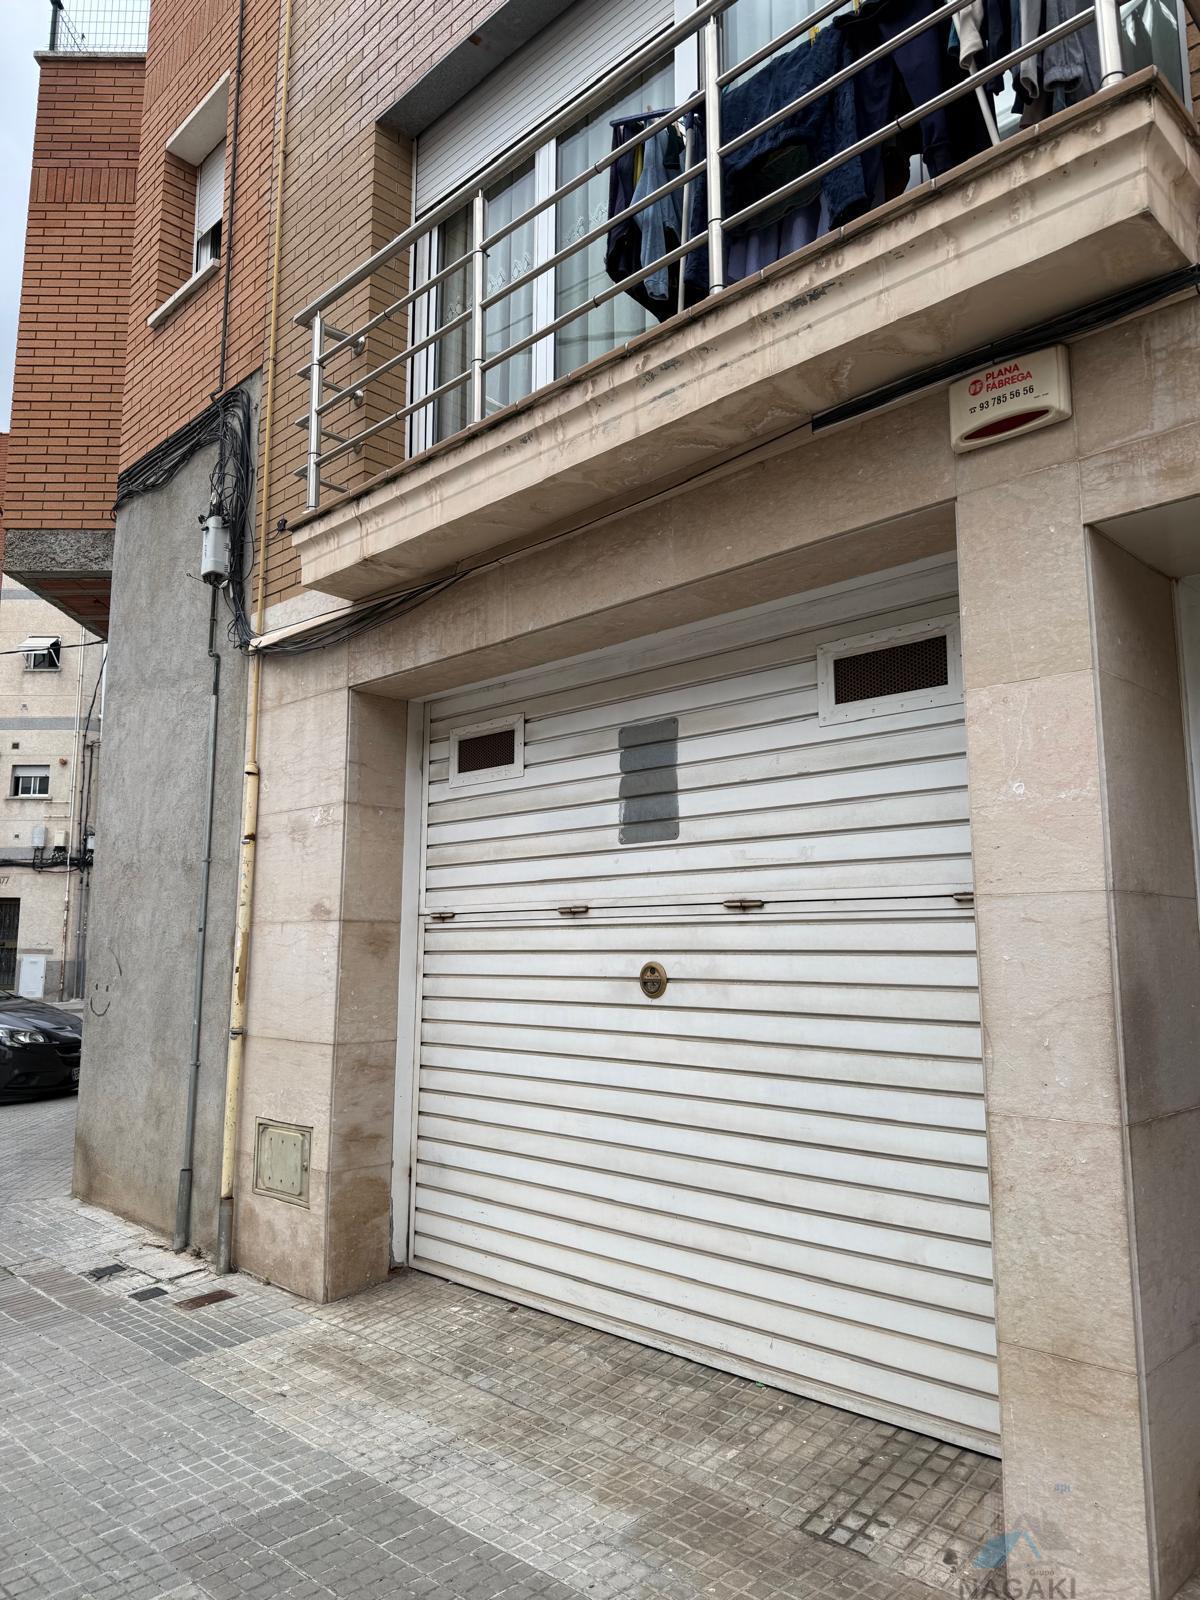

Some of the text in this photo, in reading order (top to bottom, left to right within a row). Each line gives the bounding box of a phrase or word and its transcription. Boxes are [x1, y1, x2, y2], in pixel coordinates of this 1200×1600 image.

[985, 363, 1019, 381] PLANA
[985, 370, 1033, 392] FABREGA
[979, 400, 990, 411] 93
[991, 393, 1008, 407] 785
[1009, 388, 1021, 400] 56
[1022, 384, 1034, 396] 56
